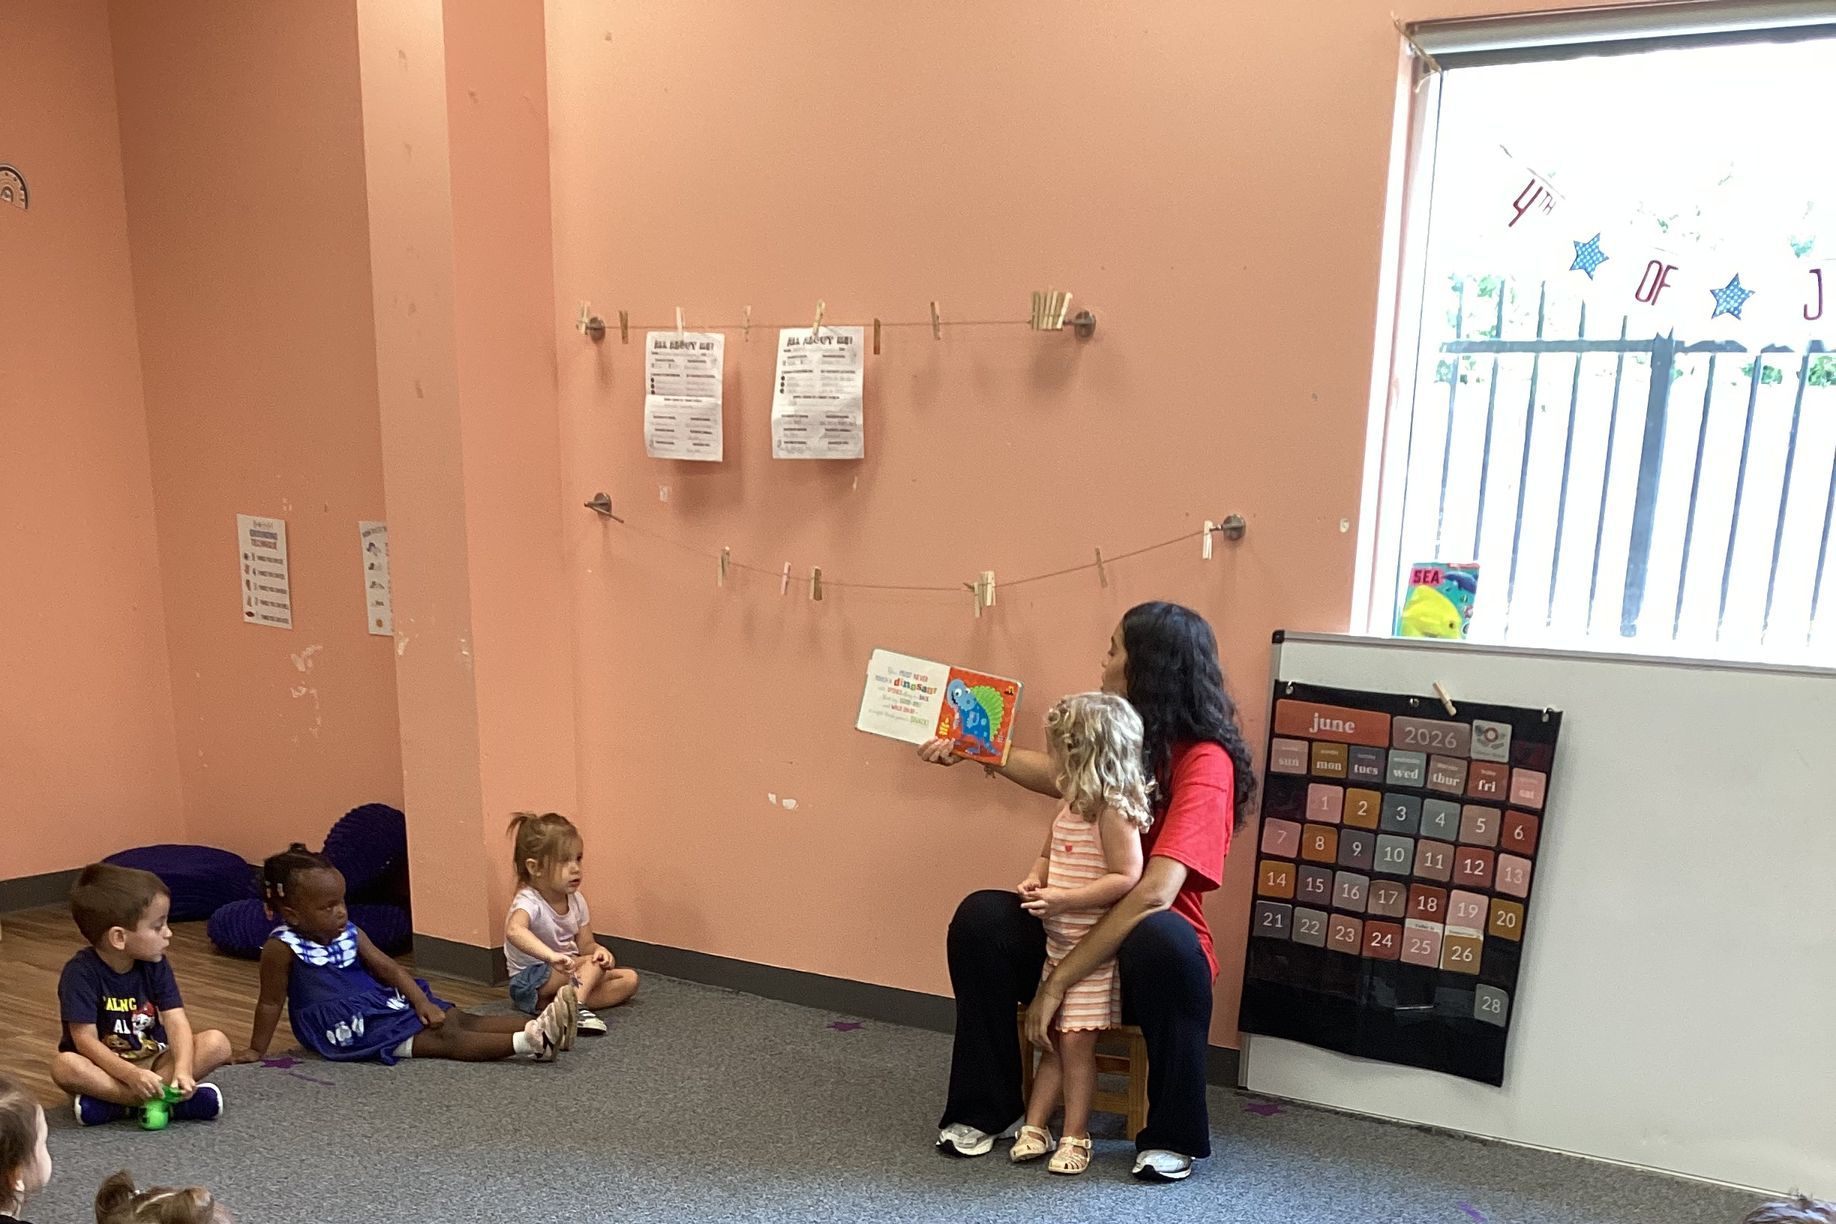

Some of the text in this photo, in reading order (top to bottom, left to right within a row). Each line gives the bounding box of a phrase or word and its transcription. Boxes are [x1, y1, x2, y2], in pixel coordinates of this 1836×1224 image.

[1635, 260, 1679, 306] OF
[1803, 268, 1823, 321] J
[1413, 569, 1440, 584] SEA
[894, 678, 937, 694] dinosaur
[1309, 712, 1356, 733] june
[1404, 727, 1457, 749] 2026
[1278, 756, 1299, 767] sun
[1316, 760, 1342, 771] mon
[1354, 764, 1378, 776] tues
[1393, 768, 1419, 780] wed
[1432, 772, 1460, 787] thur
[1478, 779, 1496, 792] fri
[1321, 796, 1329, 811] 1
[1357, 801, 1368, 816] 2
[1396, 806, 1407, 822] 3
[1435, 812, 1446, 828] 4
[1475, 818, 1486, 834] 5
[1277, 830, 1287, 844] 7
[1315, 836, 1325, 850] 8
[1383, 846, 1405, 863] 10
[1424, 852, 1444, 869] 11
[1463, 859, 1485, 876] 12
[1504, 867, 1524, 885] 13
[1267, 872, 1516, 928] 14 15 16 17 18 19 20
[1263, 912, 1473, 962] 21 22 23 24 25 26
[1481, 996, 1501, 1014] 28
